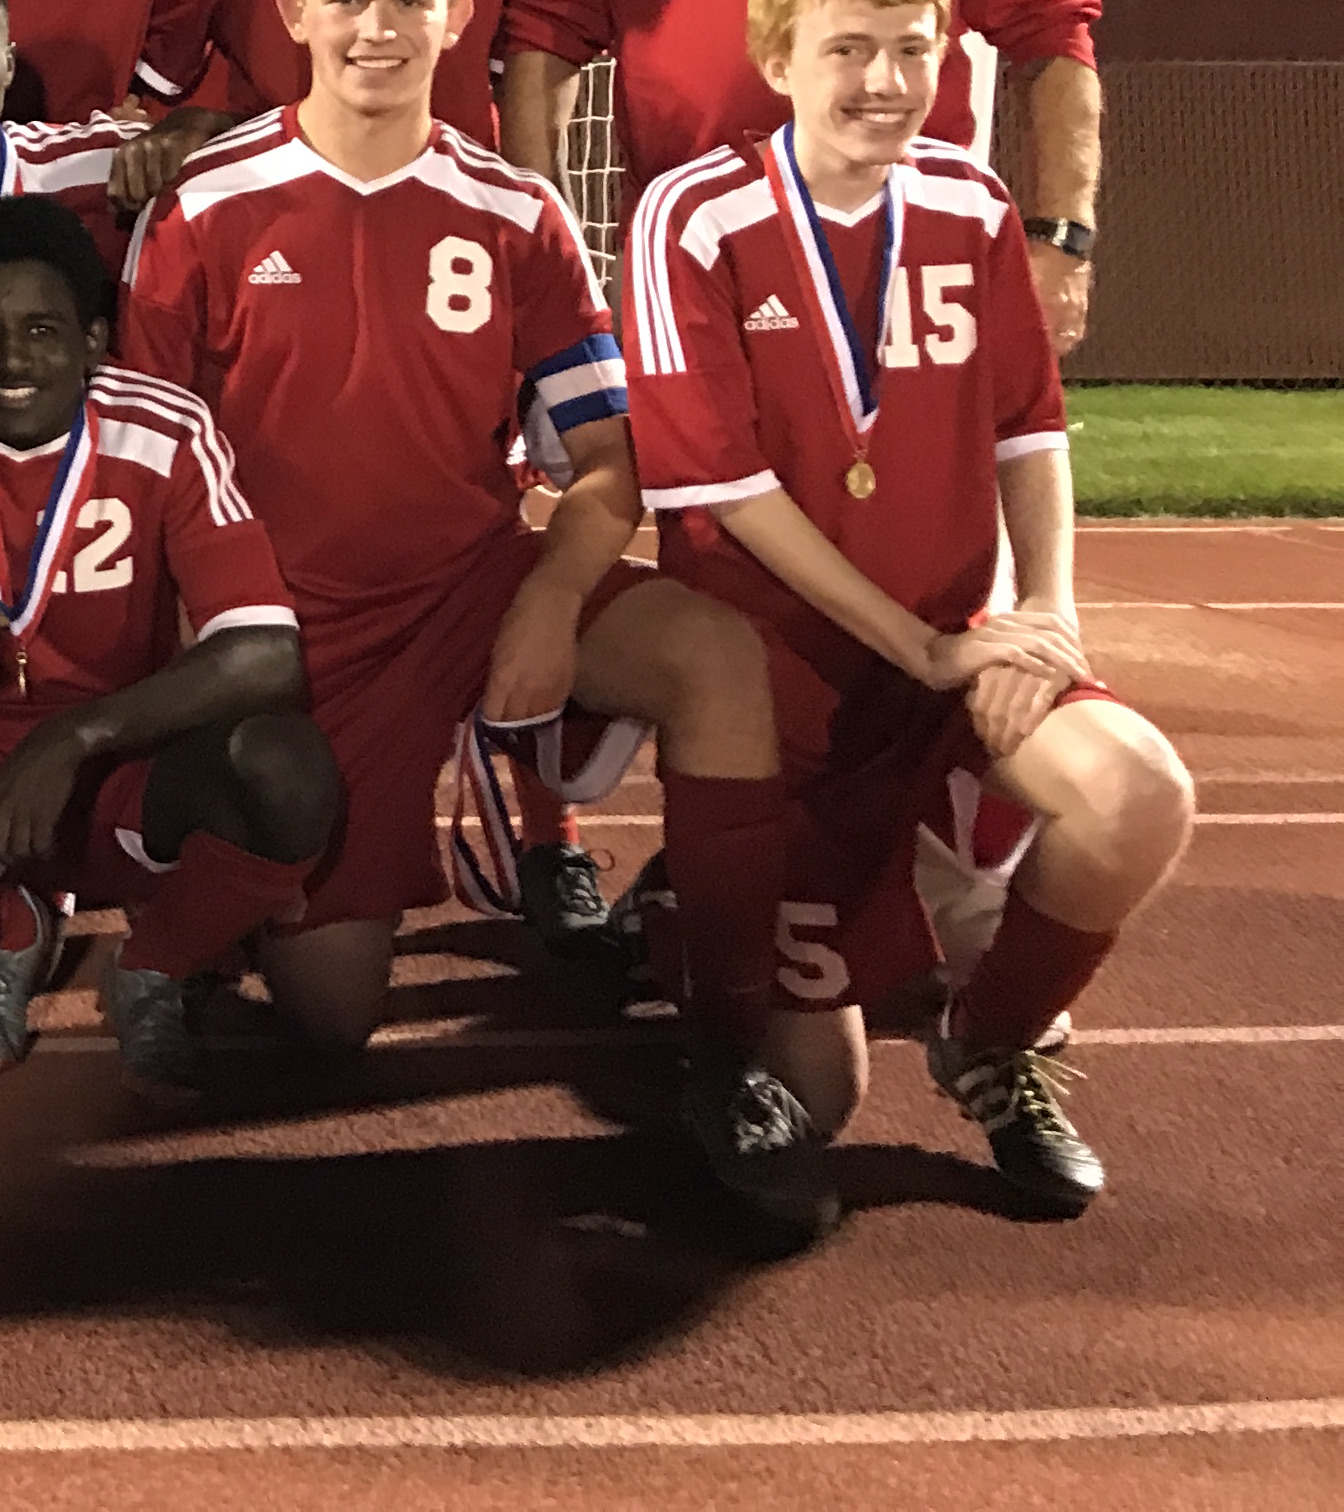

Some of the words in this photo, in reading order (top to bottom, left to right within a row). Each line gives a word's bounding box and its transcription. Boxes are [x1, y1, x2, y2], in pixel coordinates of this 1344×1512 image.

[247, 270, 303, 285] adidas
[424, 235, 494, 335] 8
[743, 315, 800, 332] adidas
[883, 262, 978, 368] 15
[36, 497, 134, 594] 2
